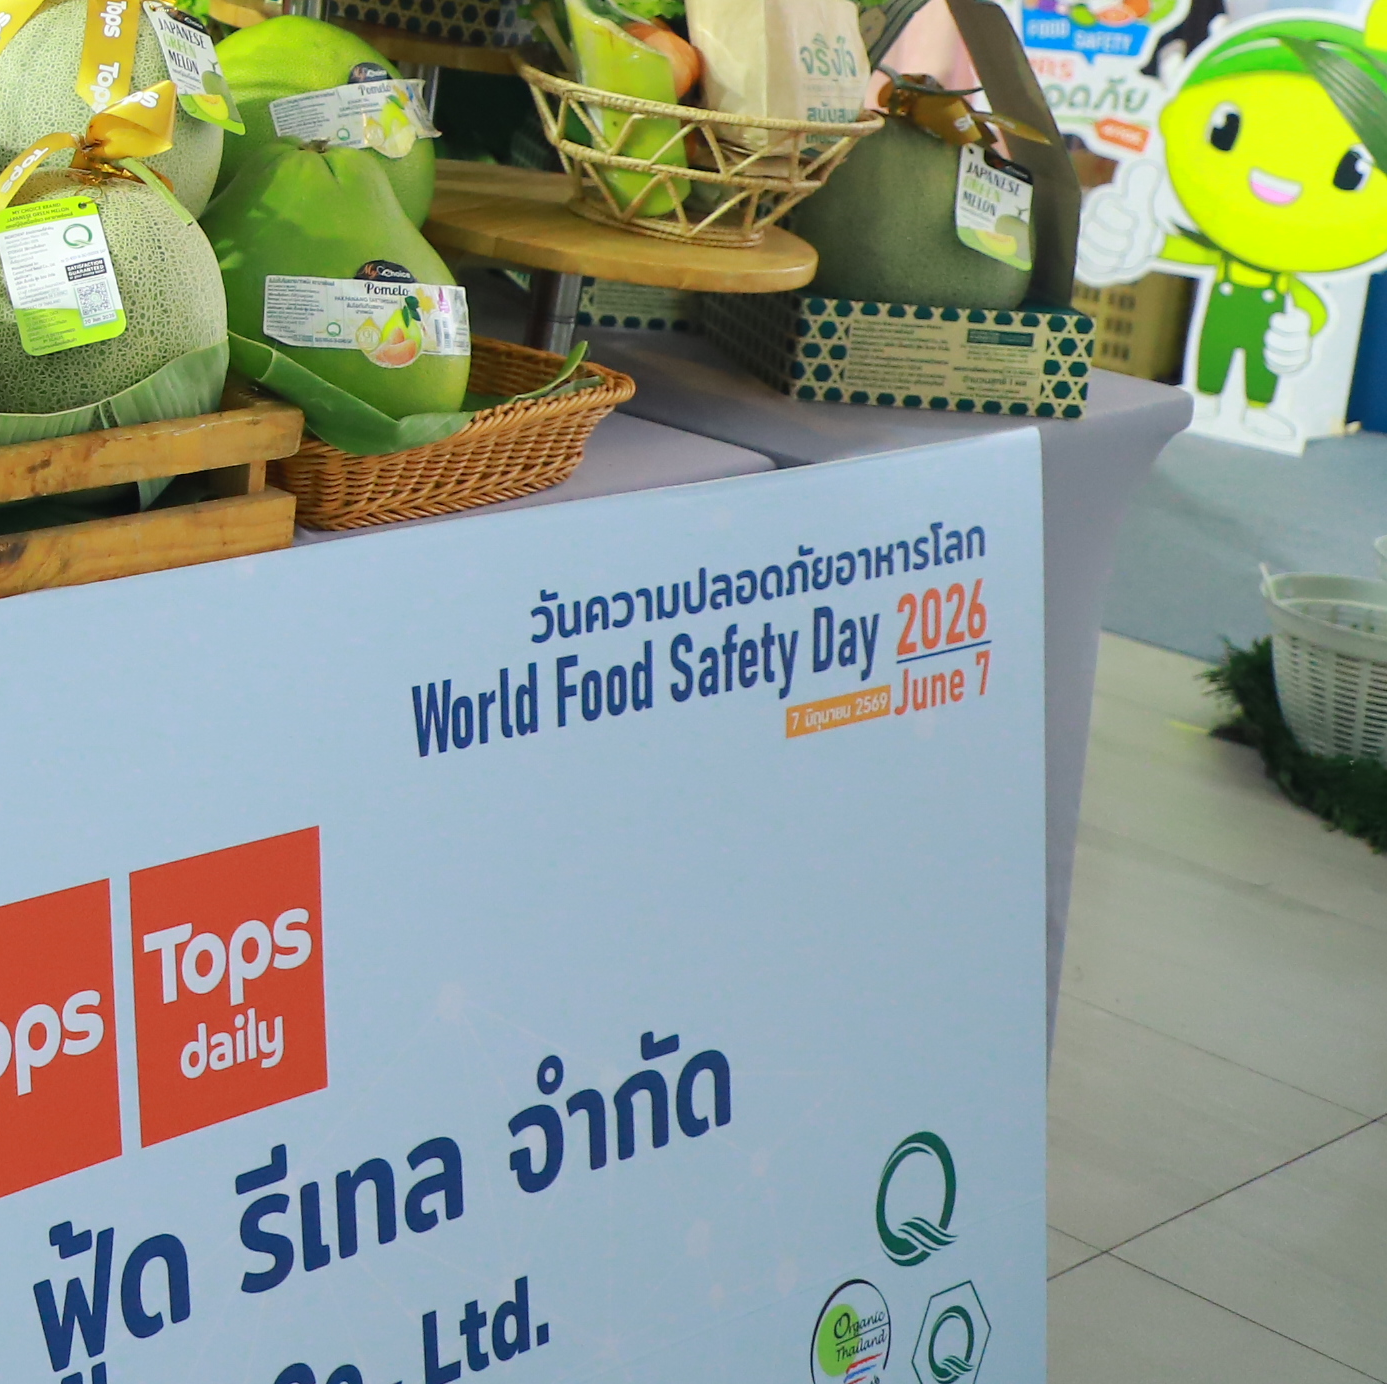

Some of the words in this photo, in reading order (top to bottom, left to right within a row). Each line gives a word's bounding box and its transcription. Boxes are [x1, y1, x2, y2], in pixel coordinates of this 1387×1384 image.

[100, 0, 127, 39] Tops
[158, 17, 207, 50] JAPANESE
[1072, 28, 1134, 52] SAFETY
[168, 49, 200, 75] MELON
[357, 82, 392, 96] Pomelo
[1045, 77, 1149, 112] อดภัย
[0, 146, 51, 194] Tops
[966, 161, 1021, 197] JAPANESE
[6, 214, 32, 224] JAPANESE
[32, 210, 51, 220] GREEN
[50, 206, 70, 216] MELON
[20, 205, 42, 215] CHOICE
[962, 191, 997, 217] MELON
[66, 259, 104, 272] SATISFACTION
[68, 264, 105, 277] GUARANTEED
[362, 263, 378, 280] My
[376, 265, 412, 279] Choice
[364, 281, 410, 298] Pomelo
[530, 521, 987, 645] วันความปลอดภัยอาหารโลก
[411, 661, 540, 758] World
[556, 639, 654, 729] Food
[669, 621, 799, 704] Safety
[812, 605, 881, 682] Day
[896, 577, 988, 657] 2026
[894, 668, 965, 716] June
[975, 647, 991, 696] 7
[791, 712, 800, 731] 7
[804, 704, 852, 731] มิถุนายน
[855, 691, 888, 716] 2569
[143, 907, 313, 1007] Tops
[180, 1007, 285, 1079] daily
[234, 1136, 465, 1295] รีเทล
[507, 1030, 732, 1193] จำกัด
[875, 1130, 959, 1268] Q
[421, 1275, 550, 1384] Ltd.
[833, 1310, 886, 1340] Organic
[835, 1328, 888, 1363] Thailand
[928, 1304, 974, 1384] Q
